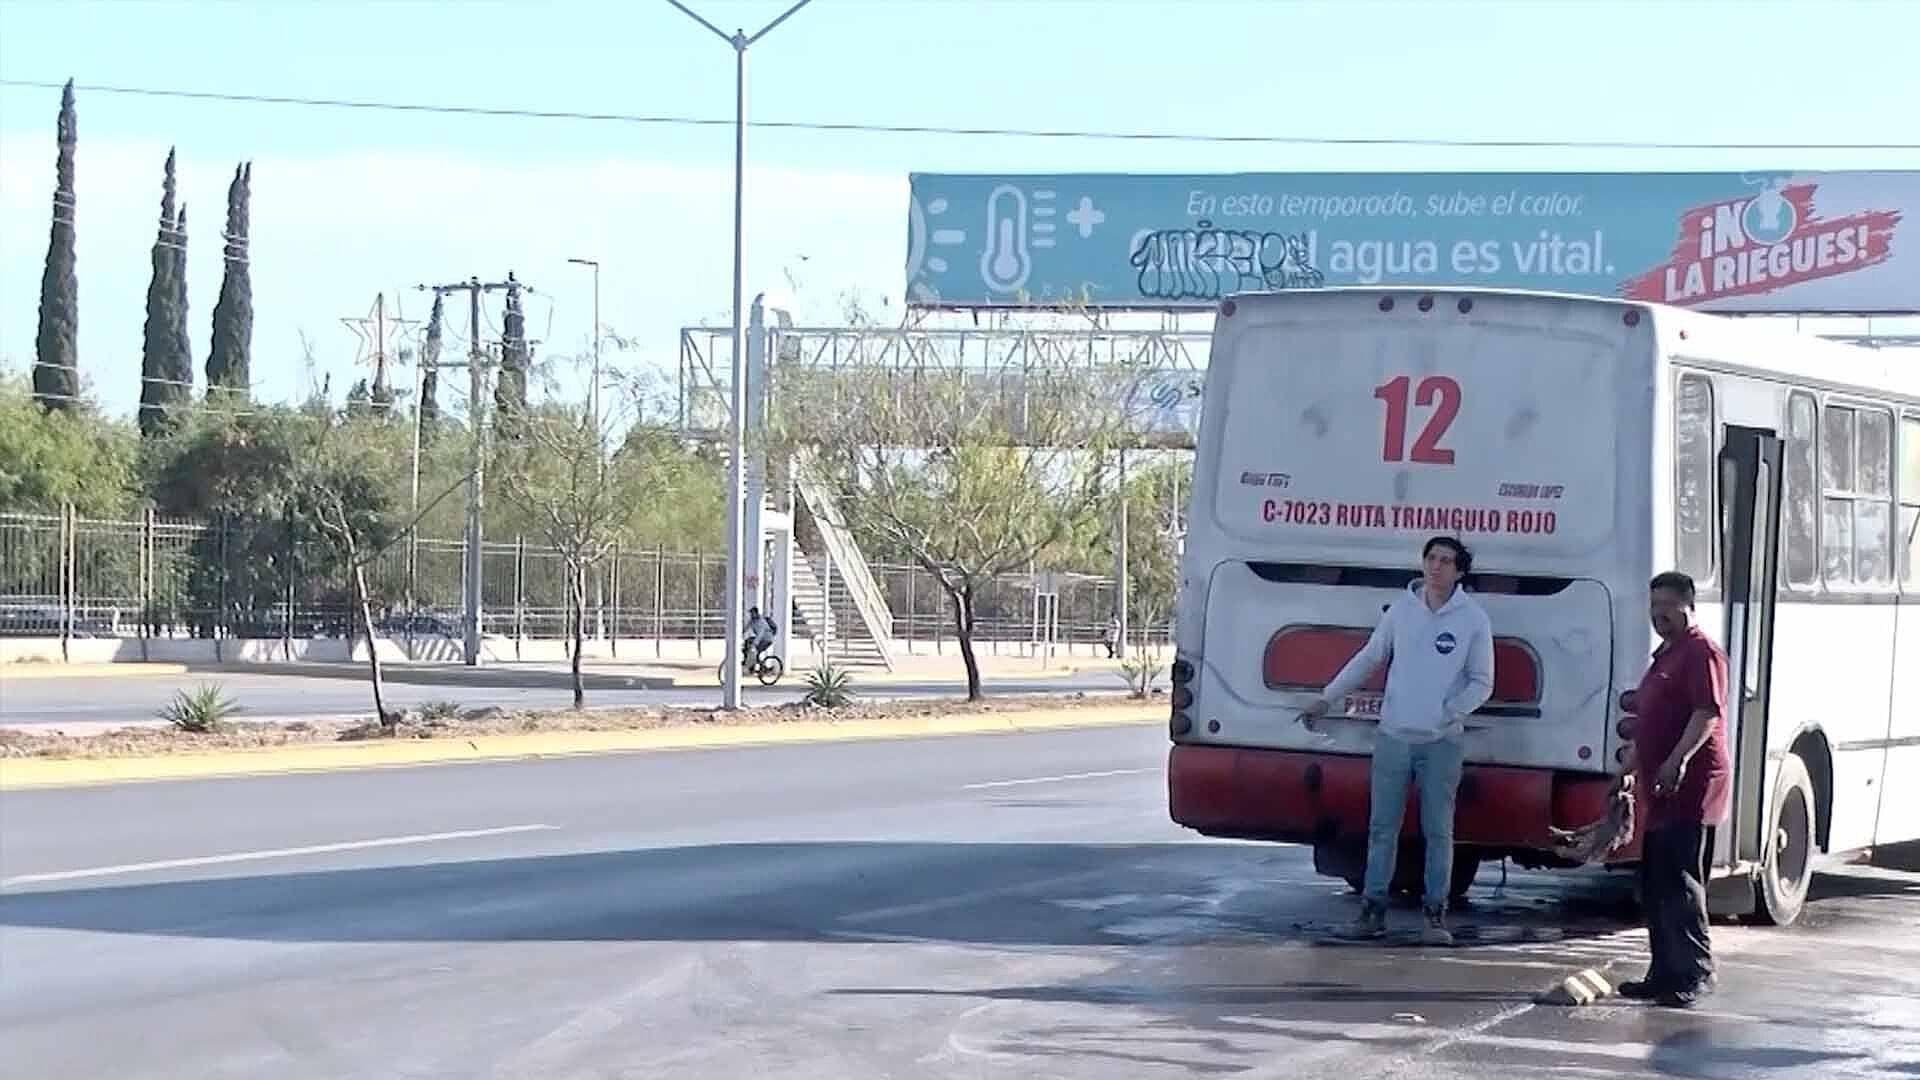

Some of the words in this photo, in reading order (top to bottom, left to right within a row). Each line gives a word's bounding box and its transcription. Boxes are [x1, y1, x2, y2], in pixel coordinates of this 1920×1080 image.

[1187, 190, 1217, 216] En
[1222, 192, 1273, 216] esta
[1279, 189, 1417, 222] temporada,
[1424, 189, 1486, 216] sube
[1492, 190, 1517, 216] el
[1520, 190, 1584, 216] calor.
[1330, 239, 1440, 284] agua
[1451, 239, 1501, 274] es
[1511, 230, 1615, 275] vital.
[1664, 262, 1706, 302] LA
[1713, 226, 1868, 291] RIEGUES!
[1374, 375, 1462, 465] 12
[1263, 500, 1331, 526] C-7023
[1336, 505, 1386, 528] RUTA
[1391, 507, 1499, 534] TRIANGULO
[1505, 512, 1556, 535] ROJO
